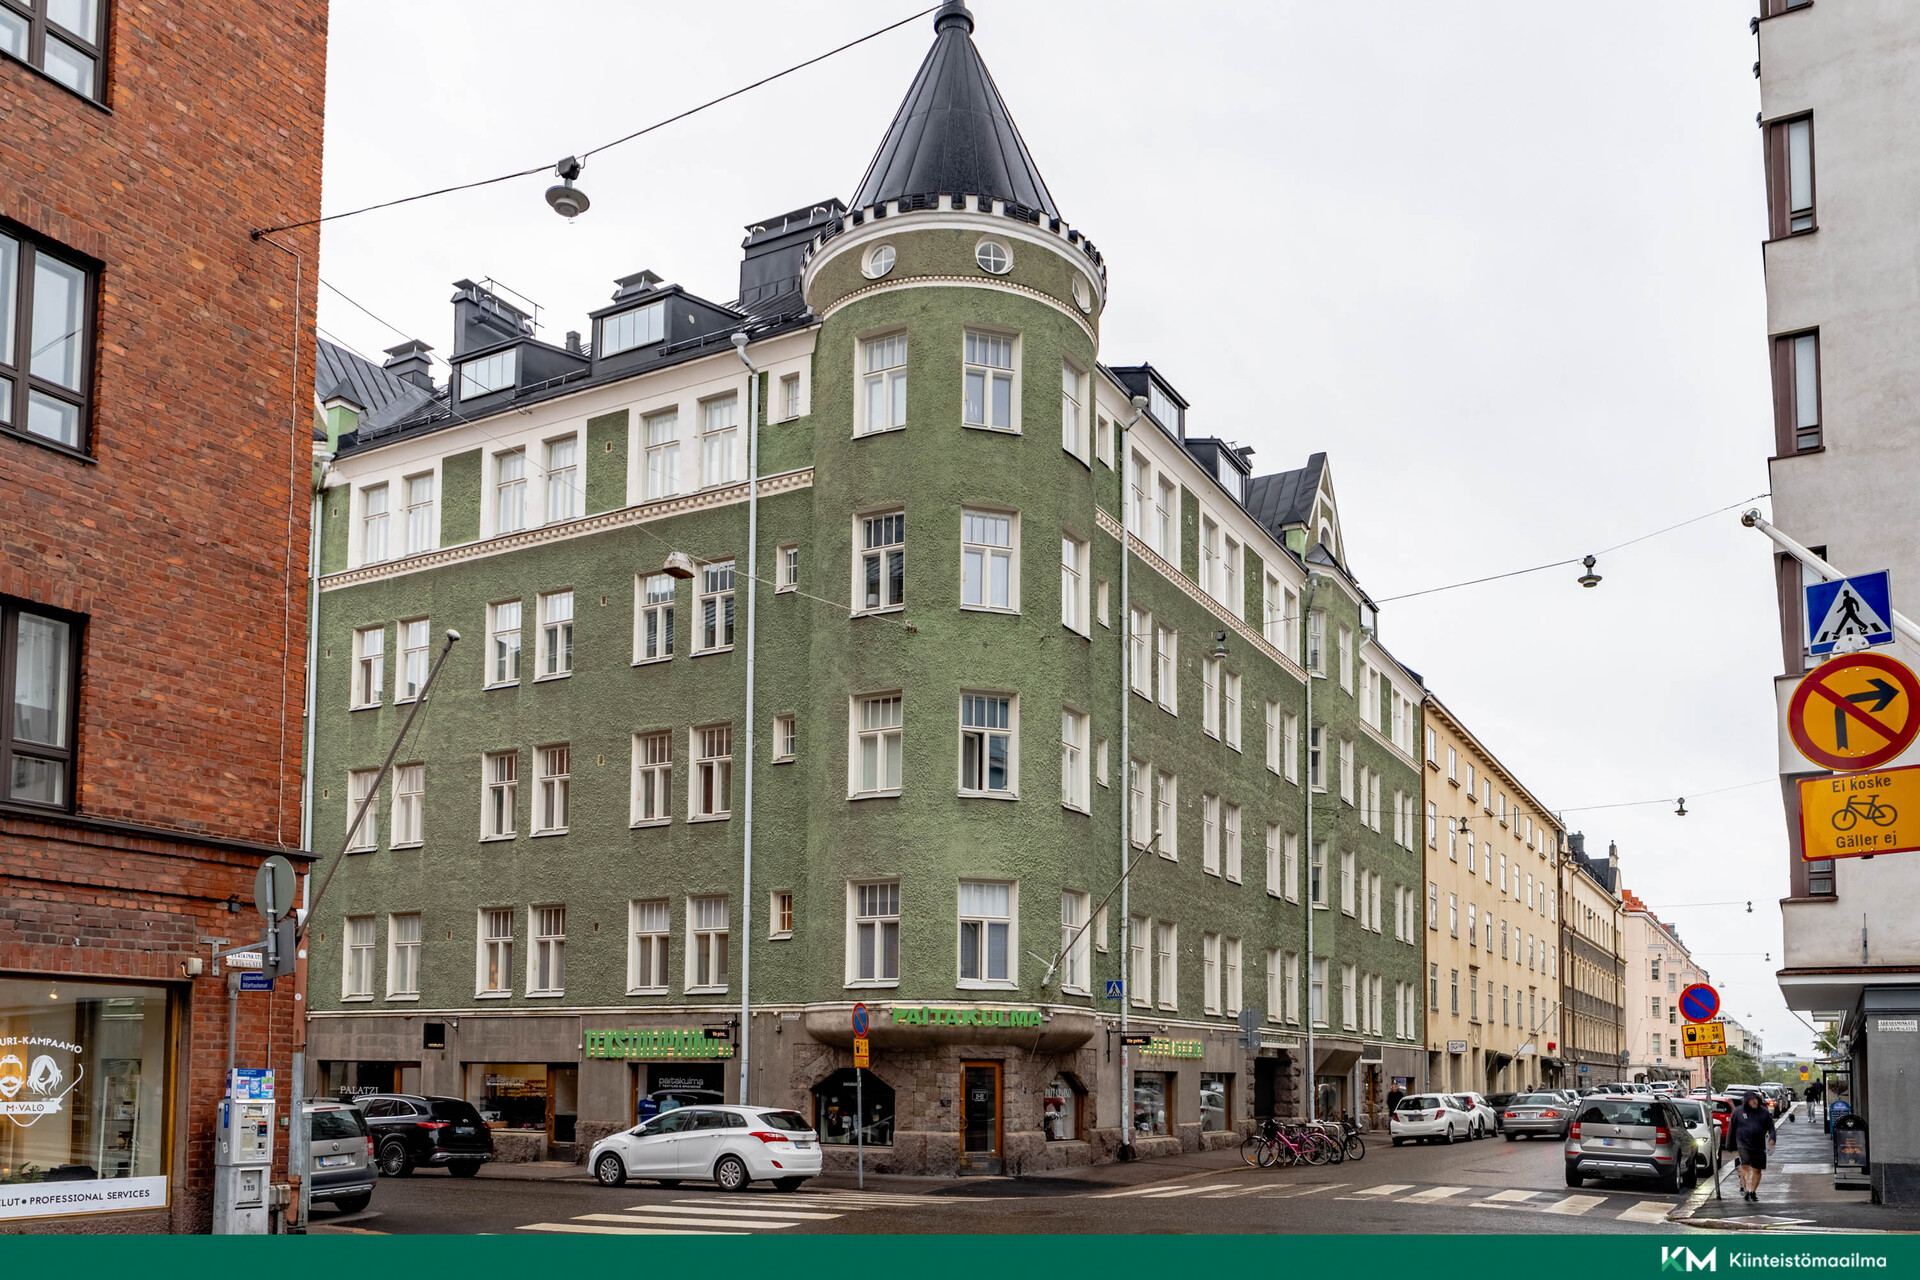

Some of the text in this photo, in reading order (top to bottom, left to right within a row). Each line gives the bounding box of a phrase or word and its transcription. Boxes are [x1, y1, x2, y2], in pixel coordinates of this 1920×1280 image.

[1832, 775, 1891, 792] Ei koske
[1836, 830, 1897, 848] Gäller ej
[893, 1006, 1042, 1027] PAITAKULMA
[340, 1086, 379, 1094] PALATZI
[0, 1189, 150, 1207] LUT PROFESSIONAL SERVICES
